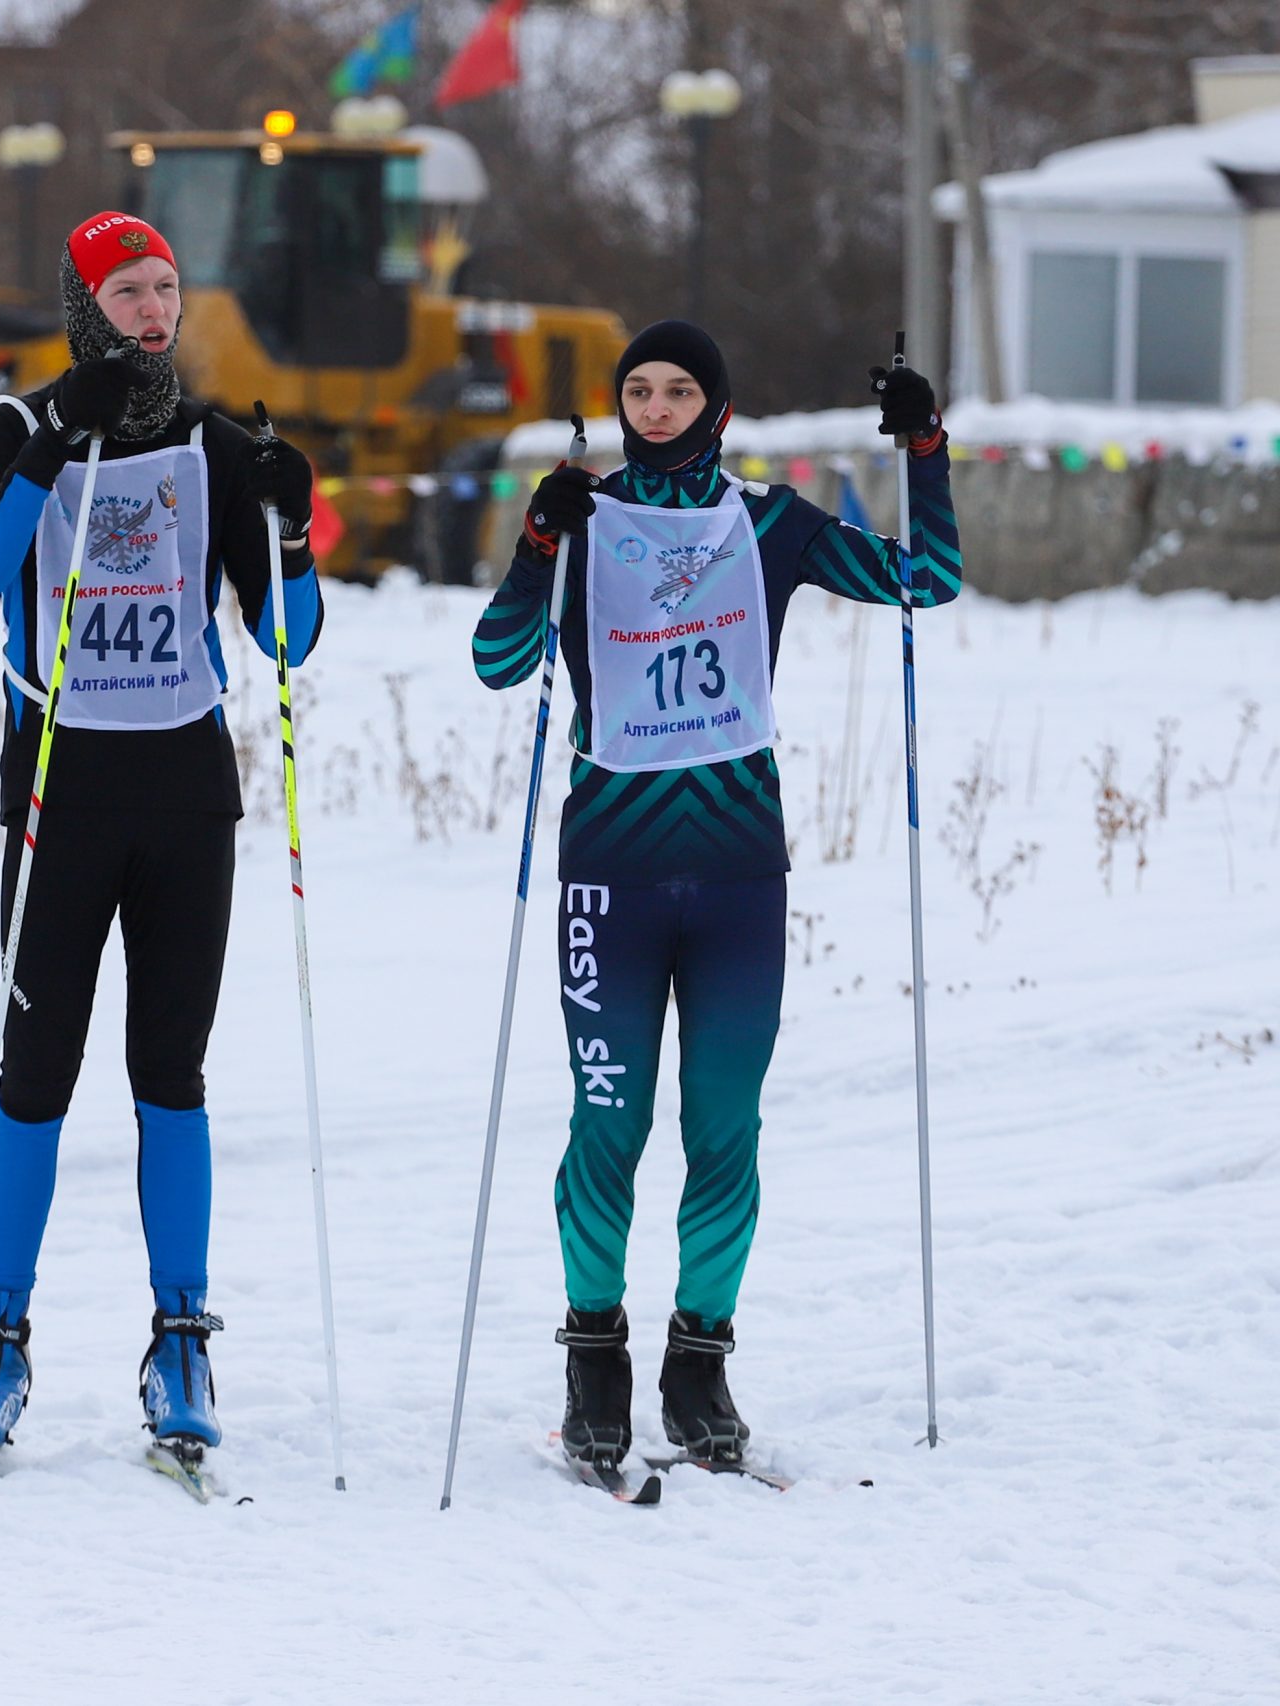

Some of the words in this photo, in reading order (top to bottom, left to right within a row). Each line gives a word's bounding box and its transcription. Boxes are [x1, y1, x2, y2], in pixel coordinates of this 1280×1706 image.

[127, 532, 158, 546] 2019
[97, 554, 152, 575] РОССИИ
[111, 584, 165, 597] РОССИИ
[80, 602, 179, 662] 442
[608, 629, 661, 643] ЛЫЖНЯ
[661, 620, 705, 640] РОССИИ
[717, 609, 746, 628] 2019
[70, 674, 155, 692] Алтайский
[646, 639, 726, 711] 173
[624, 715, 705, 737] Алтайский
[563, 882, 610, 1013] Easy
[577, 1037, 627, 1109] ski
